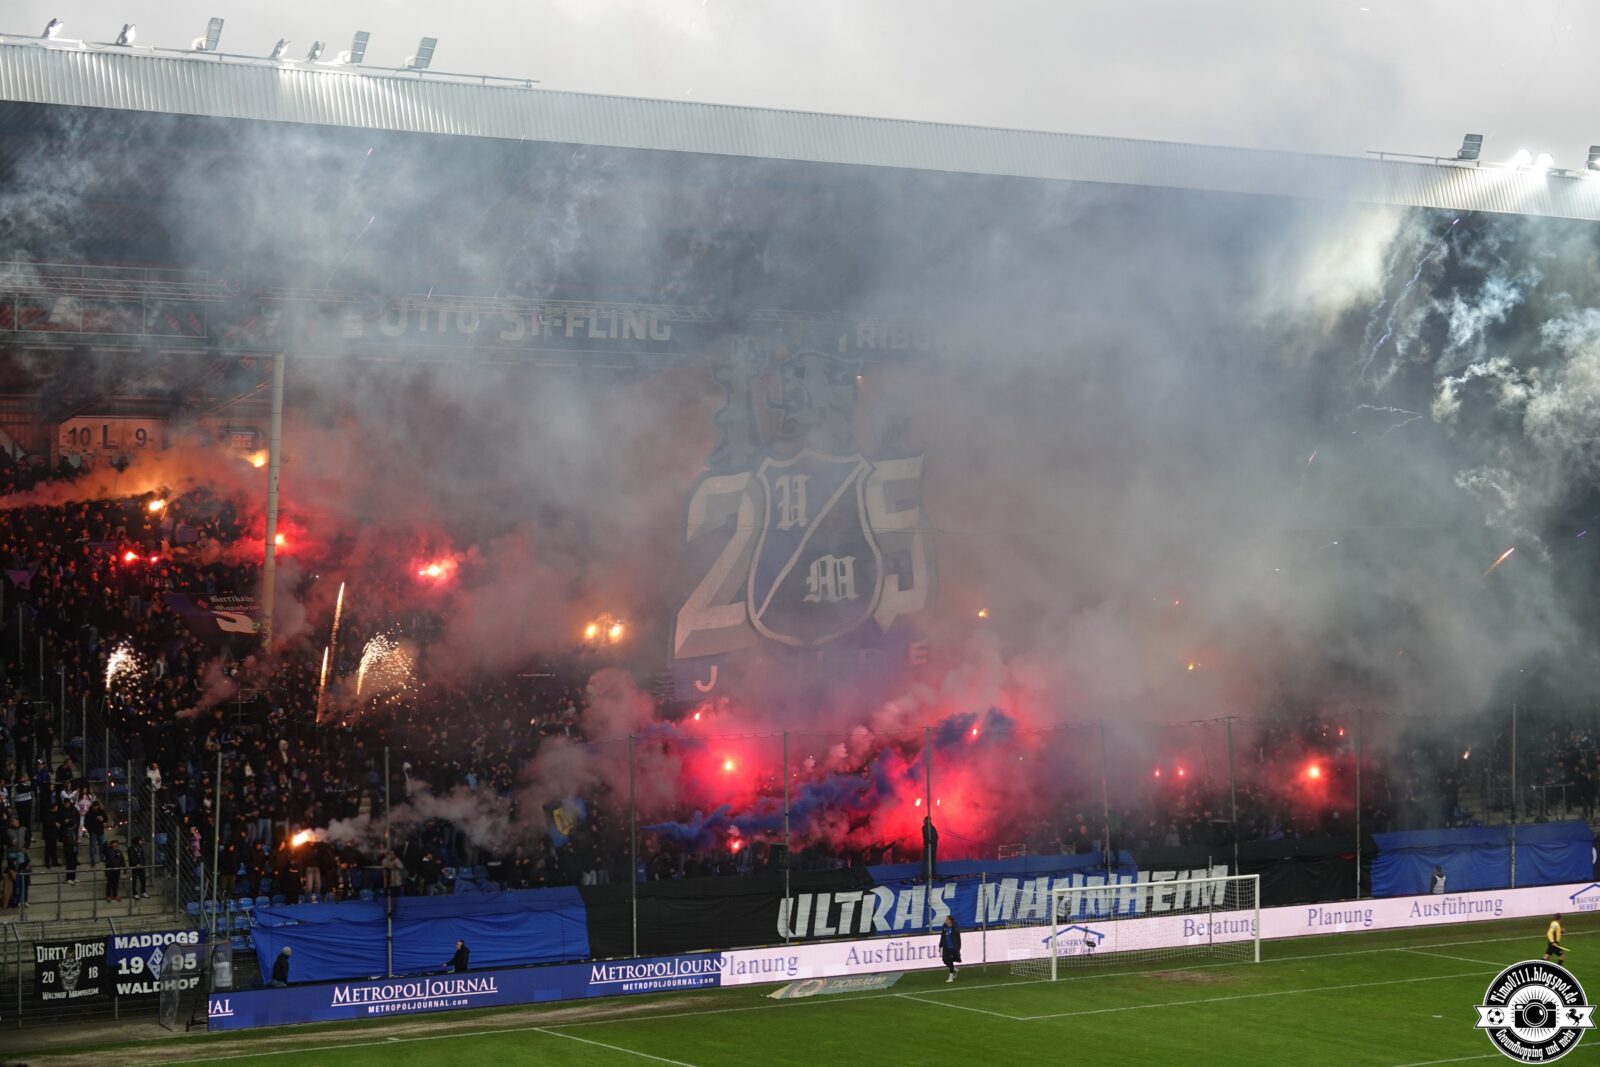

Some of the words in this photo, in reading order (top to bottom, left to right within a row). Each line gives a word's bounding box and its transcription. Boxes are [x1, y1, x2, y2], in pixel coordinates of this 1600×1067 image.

[68, 427, 91, 447] 10
[102, 425, 118, 449] L
[135, 428, 148, 447] 9
[777, 883, 957, 938] ULTRAS
[975, 865, 1228, 923] MANNHEIM
[1409, 897, 1503, 918] Ausführung
[1307, 907, 1373, 927] Planung
[115, 931, 199, 950] MADDOGS
[37, 946, 68, 963] DIRTY
[75, 943, 105, 960] DICKS
[118, 957, 144, 975] 19
[171, 953, 197, 971] 95
[42, 971, 54, 983] 20
[88, 966, 98, 979] 18
[42, 991, 67, 1001] WALDHOF
[116, 977, 200, 995] WALDHOF
